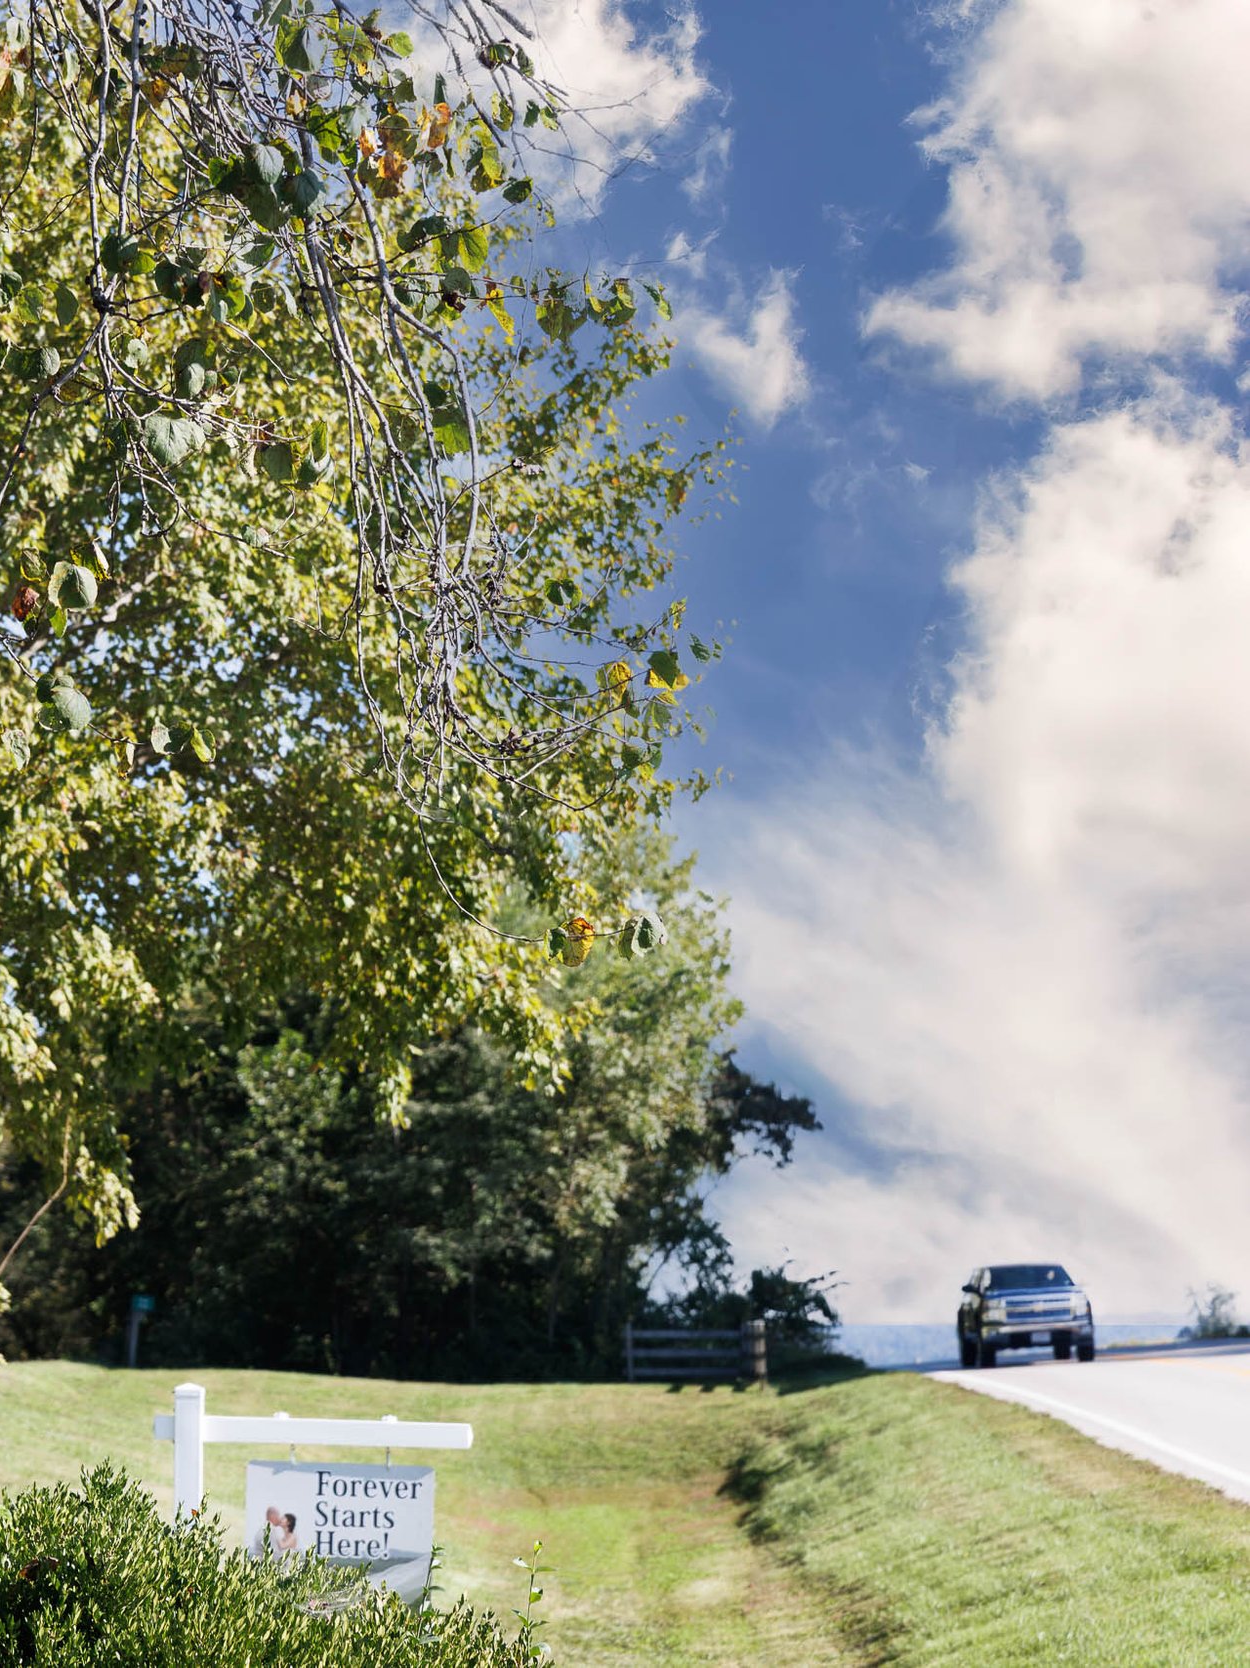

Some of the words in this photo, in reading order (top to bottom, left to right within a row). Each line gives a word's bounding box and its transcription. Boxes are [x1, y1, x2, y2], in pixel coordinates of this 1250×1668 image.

[315, 1470, 423, 1499] Forever
[314, 1500, 395, 1529] Starts
[315, 1530, 390, 1558] Here!
